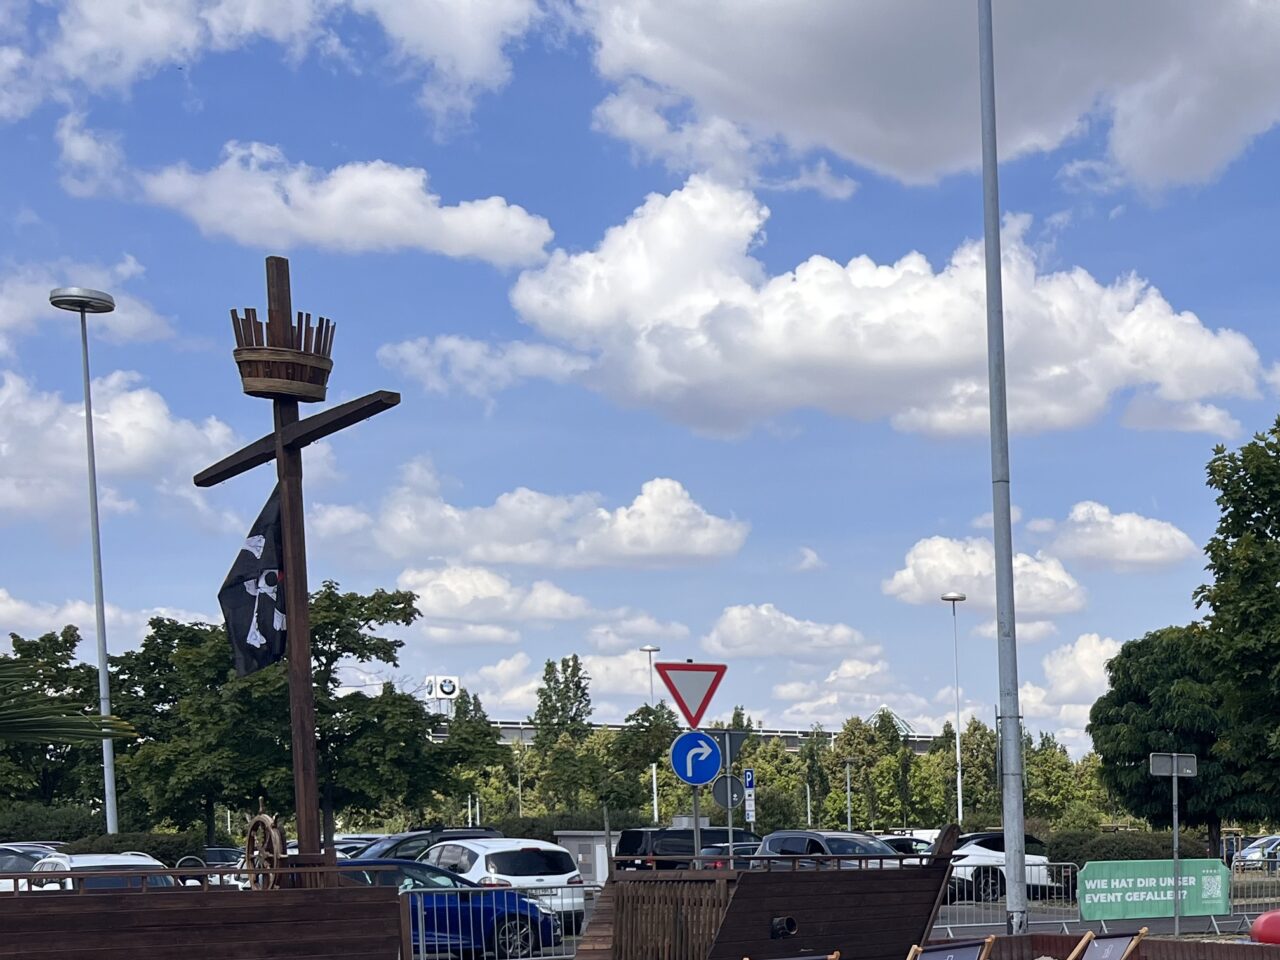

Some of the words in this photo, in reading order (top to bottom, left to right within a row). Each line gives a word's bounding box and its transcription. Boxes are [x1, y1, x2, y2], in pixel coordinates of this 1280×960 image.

[746, 771, 752, 787] P
[1085, 879, 1108, 889] WIE
[1111, 878, 1134, 888] HAT
[1137, 877, 1156, 887] DIR
[1085, 892, 1122, 903] EVENT
[1125, 890, 1187, 902] GEFALLE?
